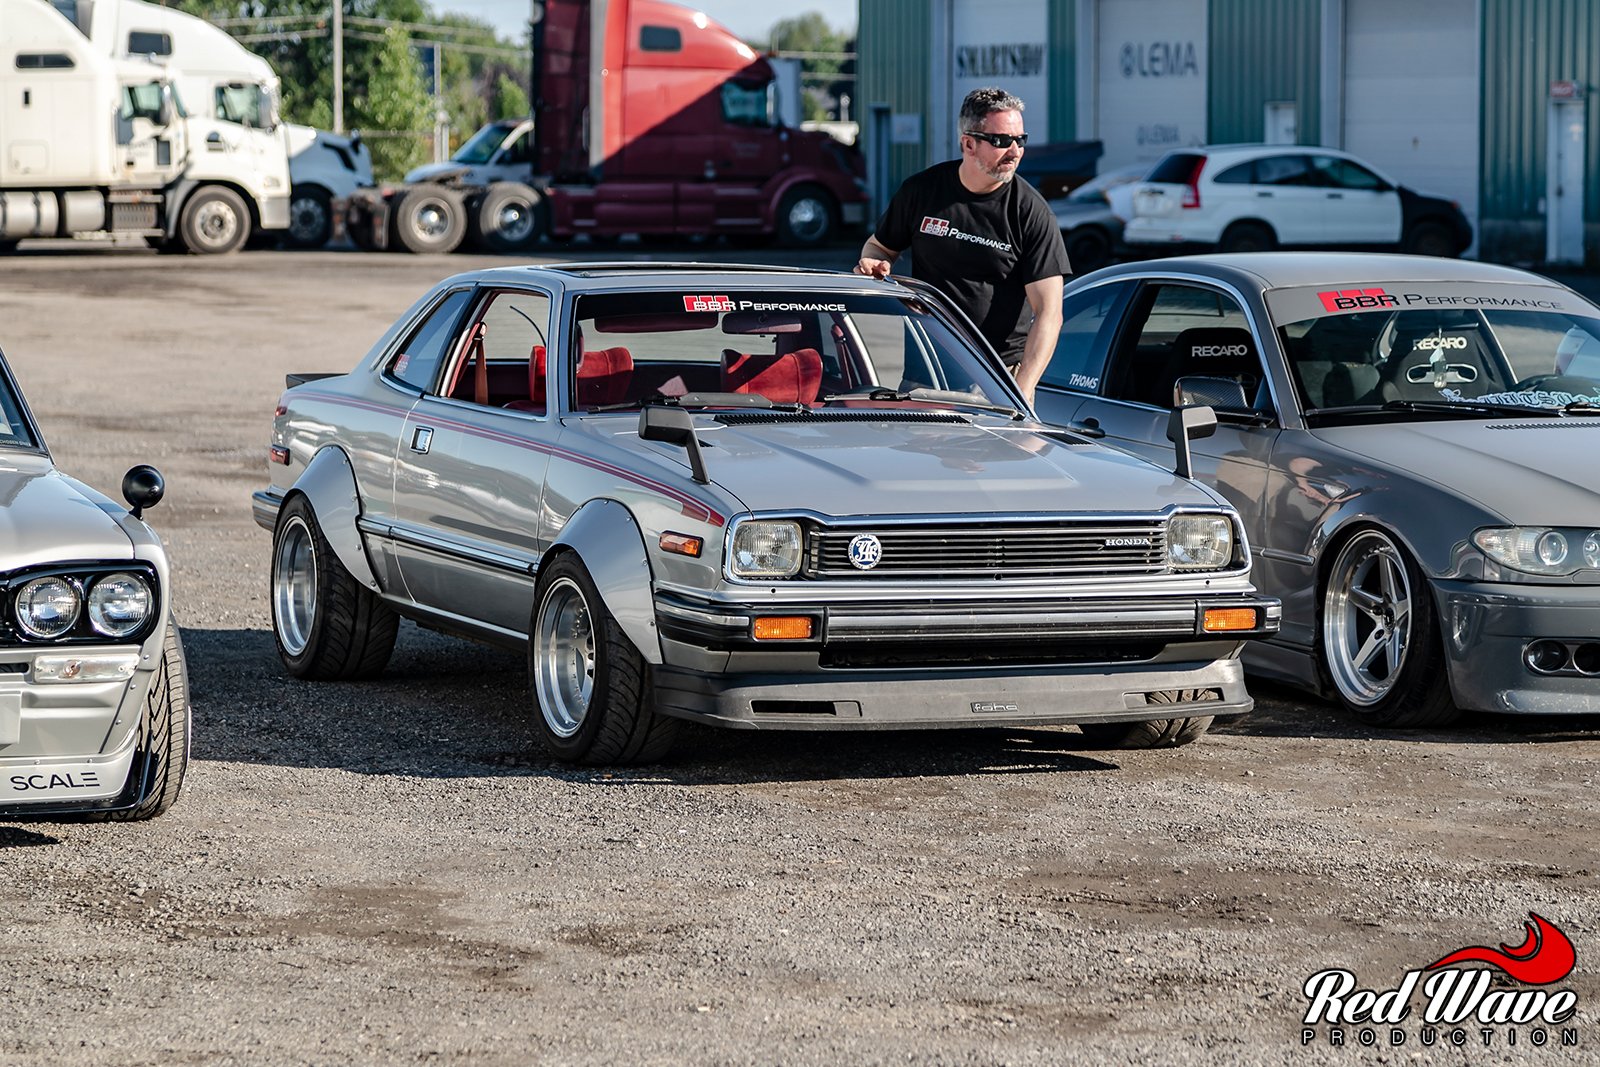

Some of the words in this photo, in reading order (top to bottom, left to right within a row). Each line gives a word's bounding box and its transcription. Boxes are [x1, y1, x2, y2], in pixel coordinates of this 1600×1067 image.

[1334, 294, 1400, 310] BBR
[1191, 344, 1248, 358] RECARO
[1412, 336, 1468, 351] RECARO
[1068, 373, 1099, 390] THOMS
[1105, 538, 1150, 547] HONDA
[10, 771, 100, 791] SCALE
